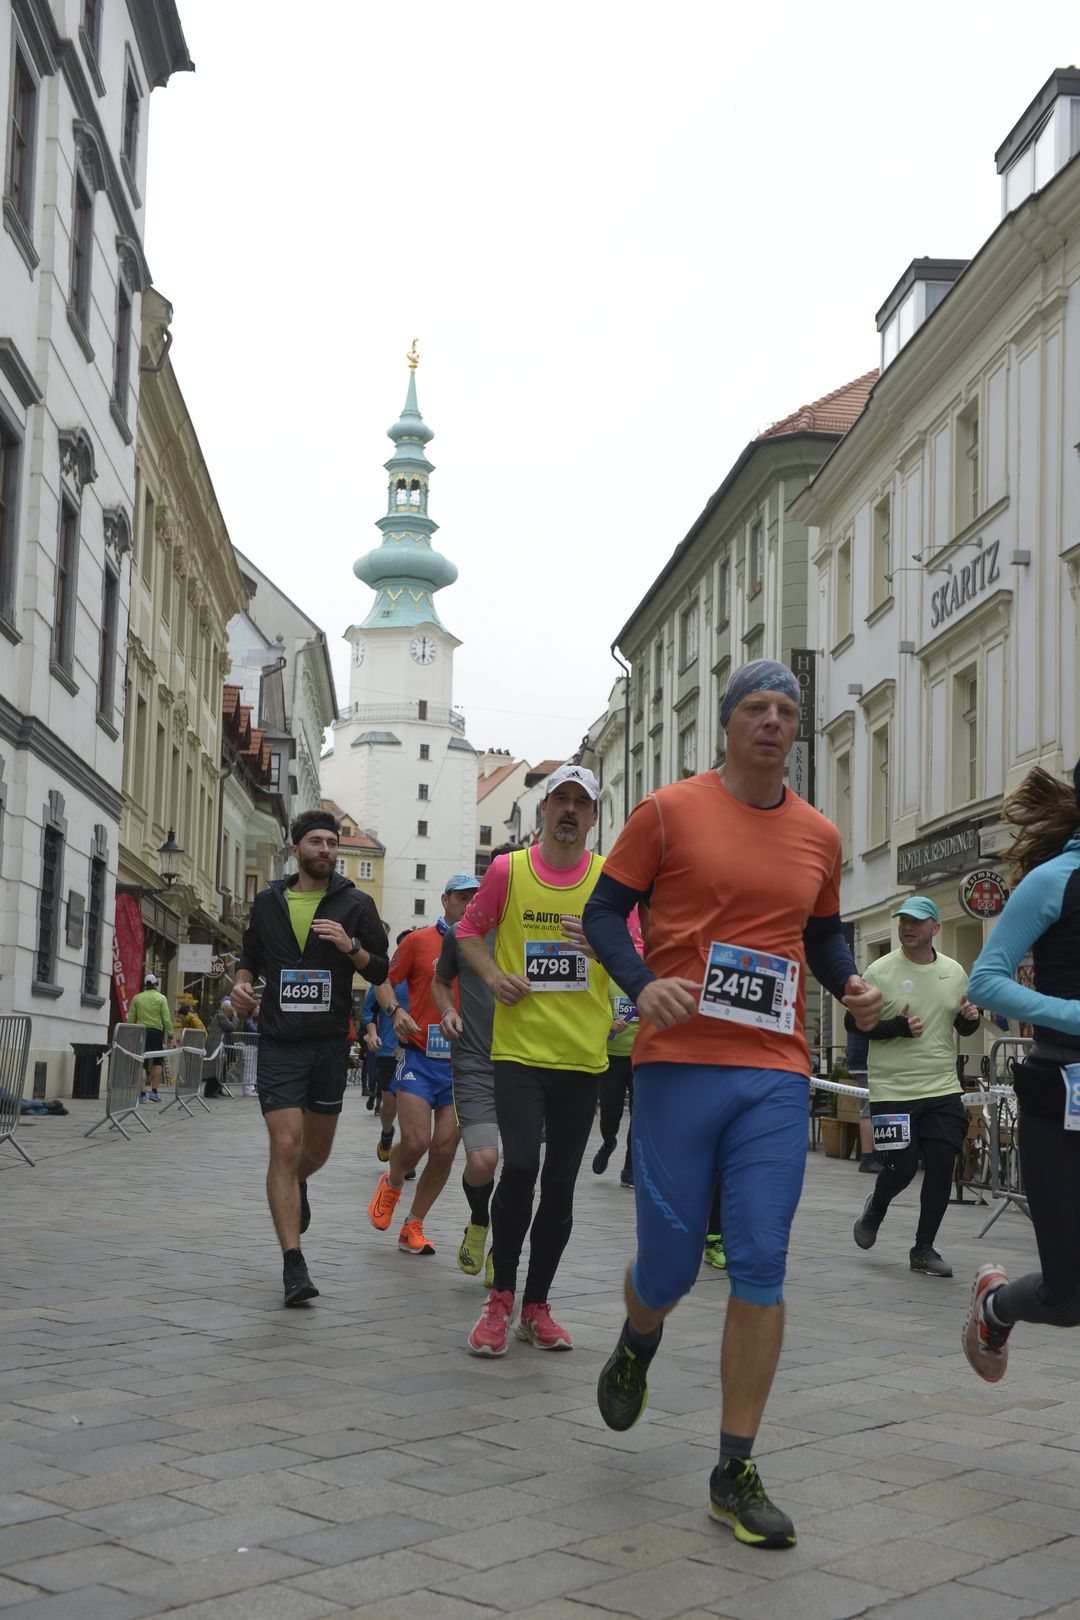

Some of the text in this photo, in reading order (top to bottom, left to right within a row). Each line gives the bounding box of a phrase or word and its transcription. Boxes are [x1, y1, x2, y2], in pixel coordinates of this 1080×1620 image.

[931, 539, 1000, 628] SKARITZ
[797, 656, 810, 737] HOTEL
[795, 746, 803, 798] SKARIT
[923, 846, 931, 865] &
[527, 958, 570, 975] 4798
[282, 984, 319, 998] 4698
[707, 968, 764, 1002] 2415
[619, 1004, 636, 1014] 561
[874, 1126, 897, 1139] 4441
